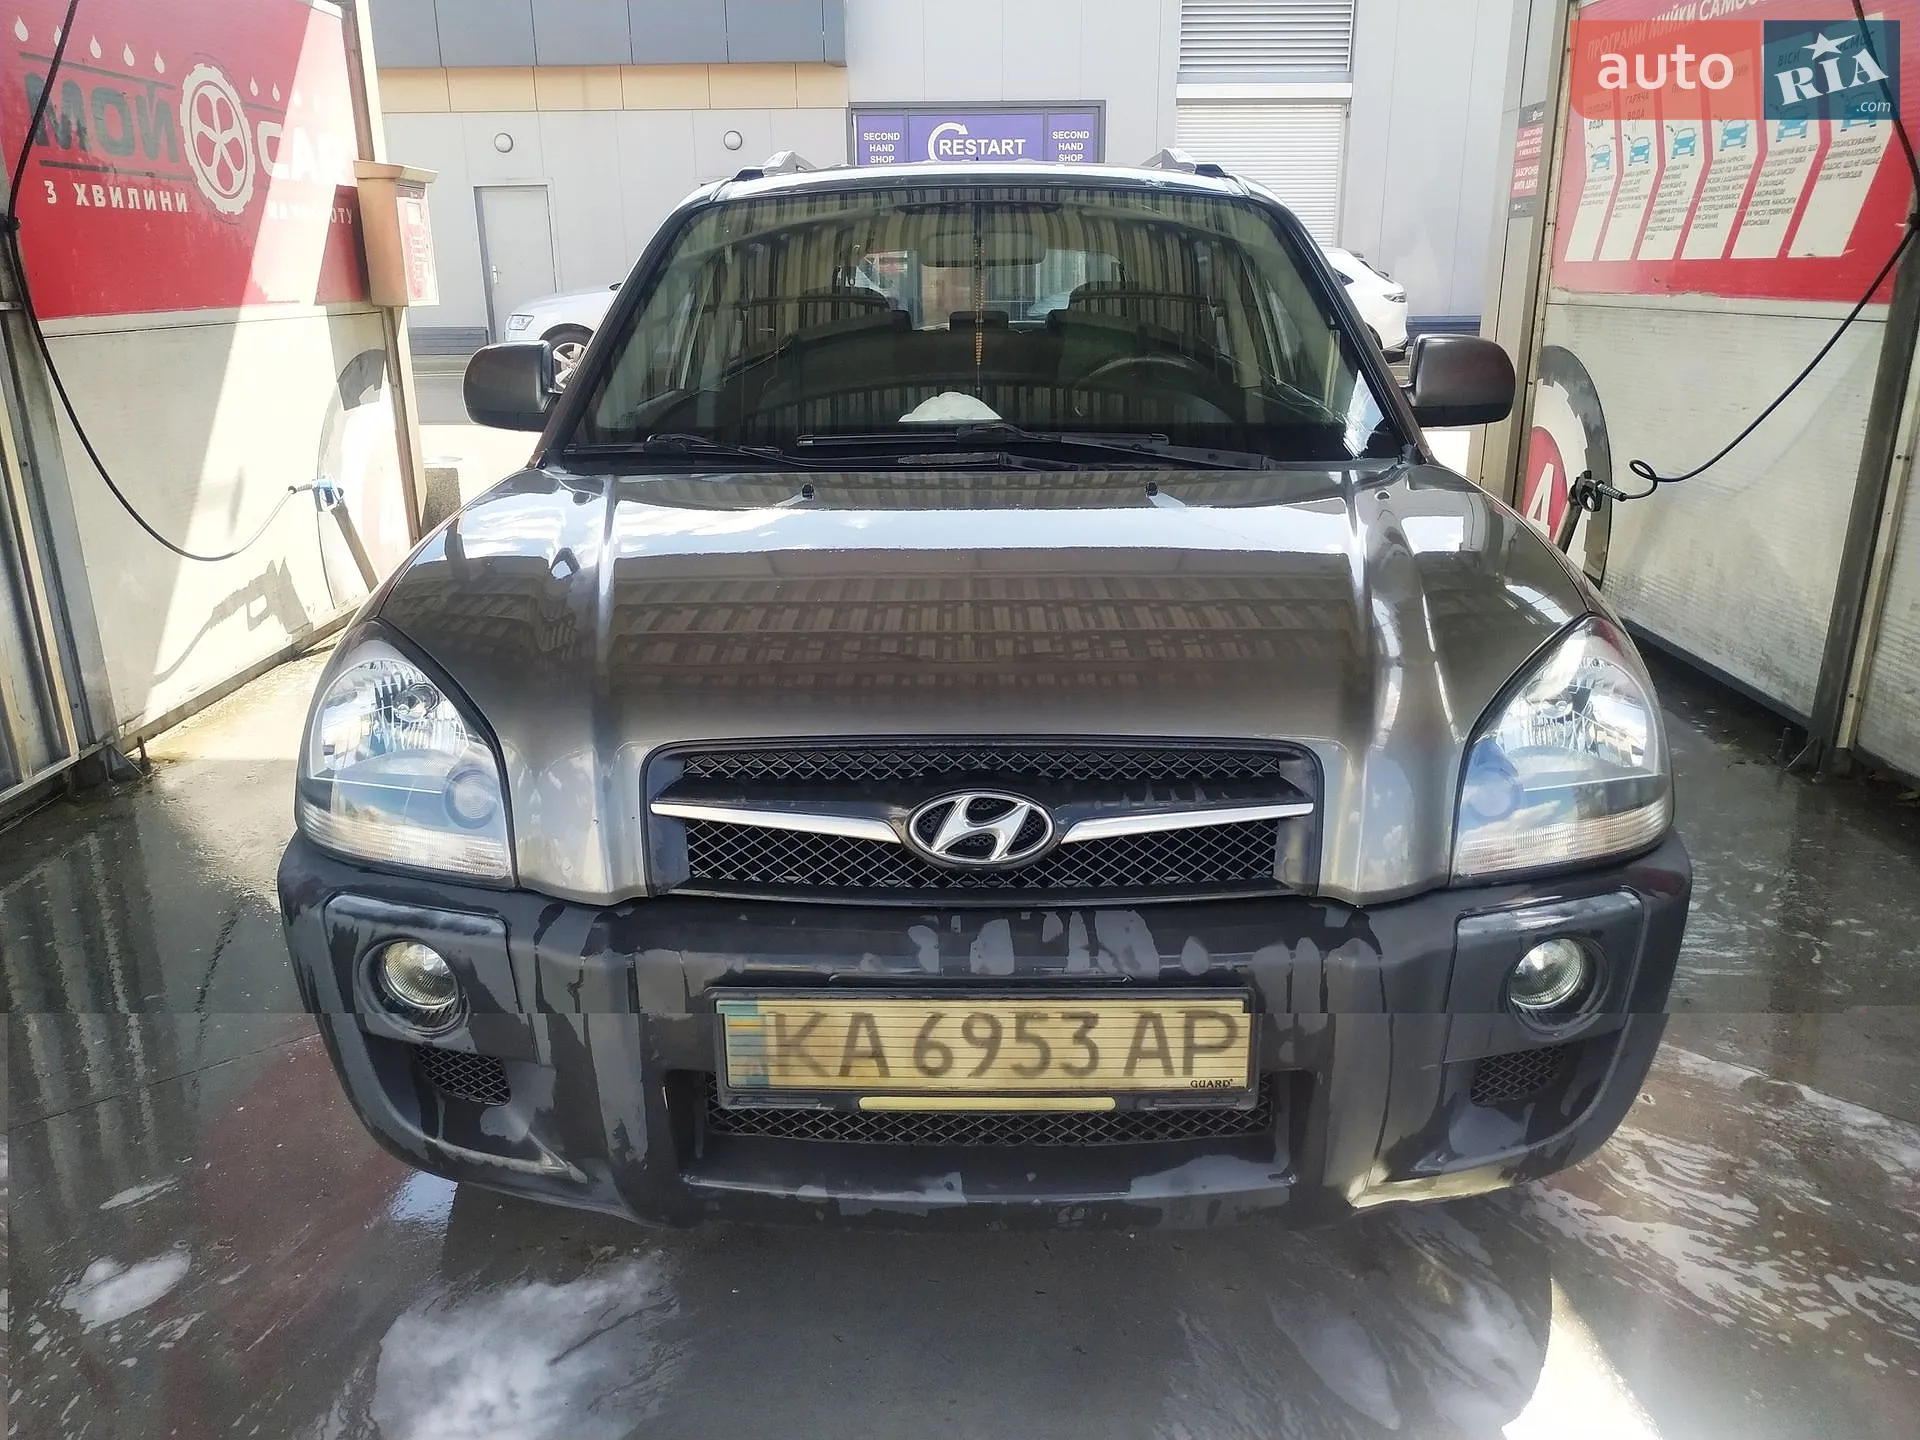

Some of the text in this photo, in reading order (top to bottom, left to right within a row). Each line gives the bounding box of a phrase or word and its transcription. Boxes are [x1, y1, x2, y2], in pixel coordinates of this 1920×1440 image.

[863, 132, 900, 141] SECOND
[1052, 131, 1090, 139] SECOND
[869, 144, 895, 152] HAND
[939, 138, 1026, 156] RESTART
[1058, 142, 1084, 151] HAND
[870, 155, 895, 164] SHOP
[1058, 153, 1084, 162] SHOP
[73, 183, 188, 213] ХВИЛИНИ
[913, 1011, 1099, 1078] 6953
[1190, 1079, 1231, 1088] GUARD
